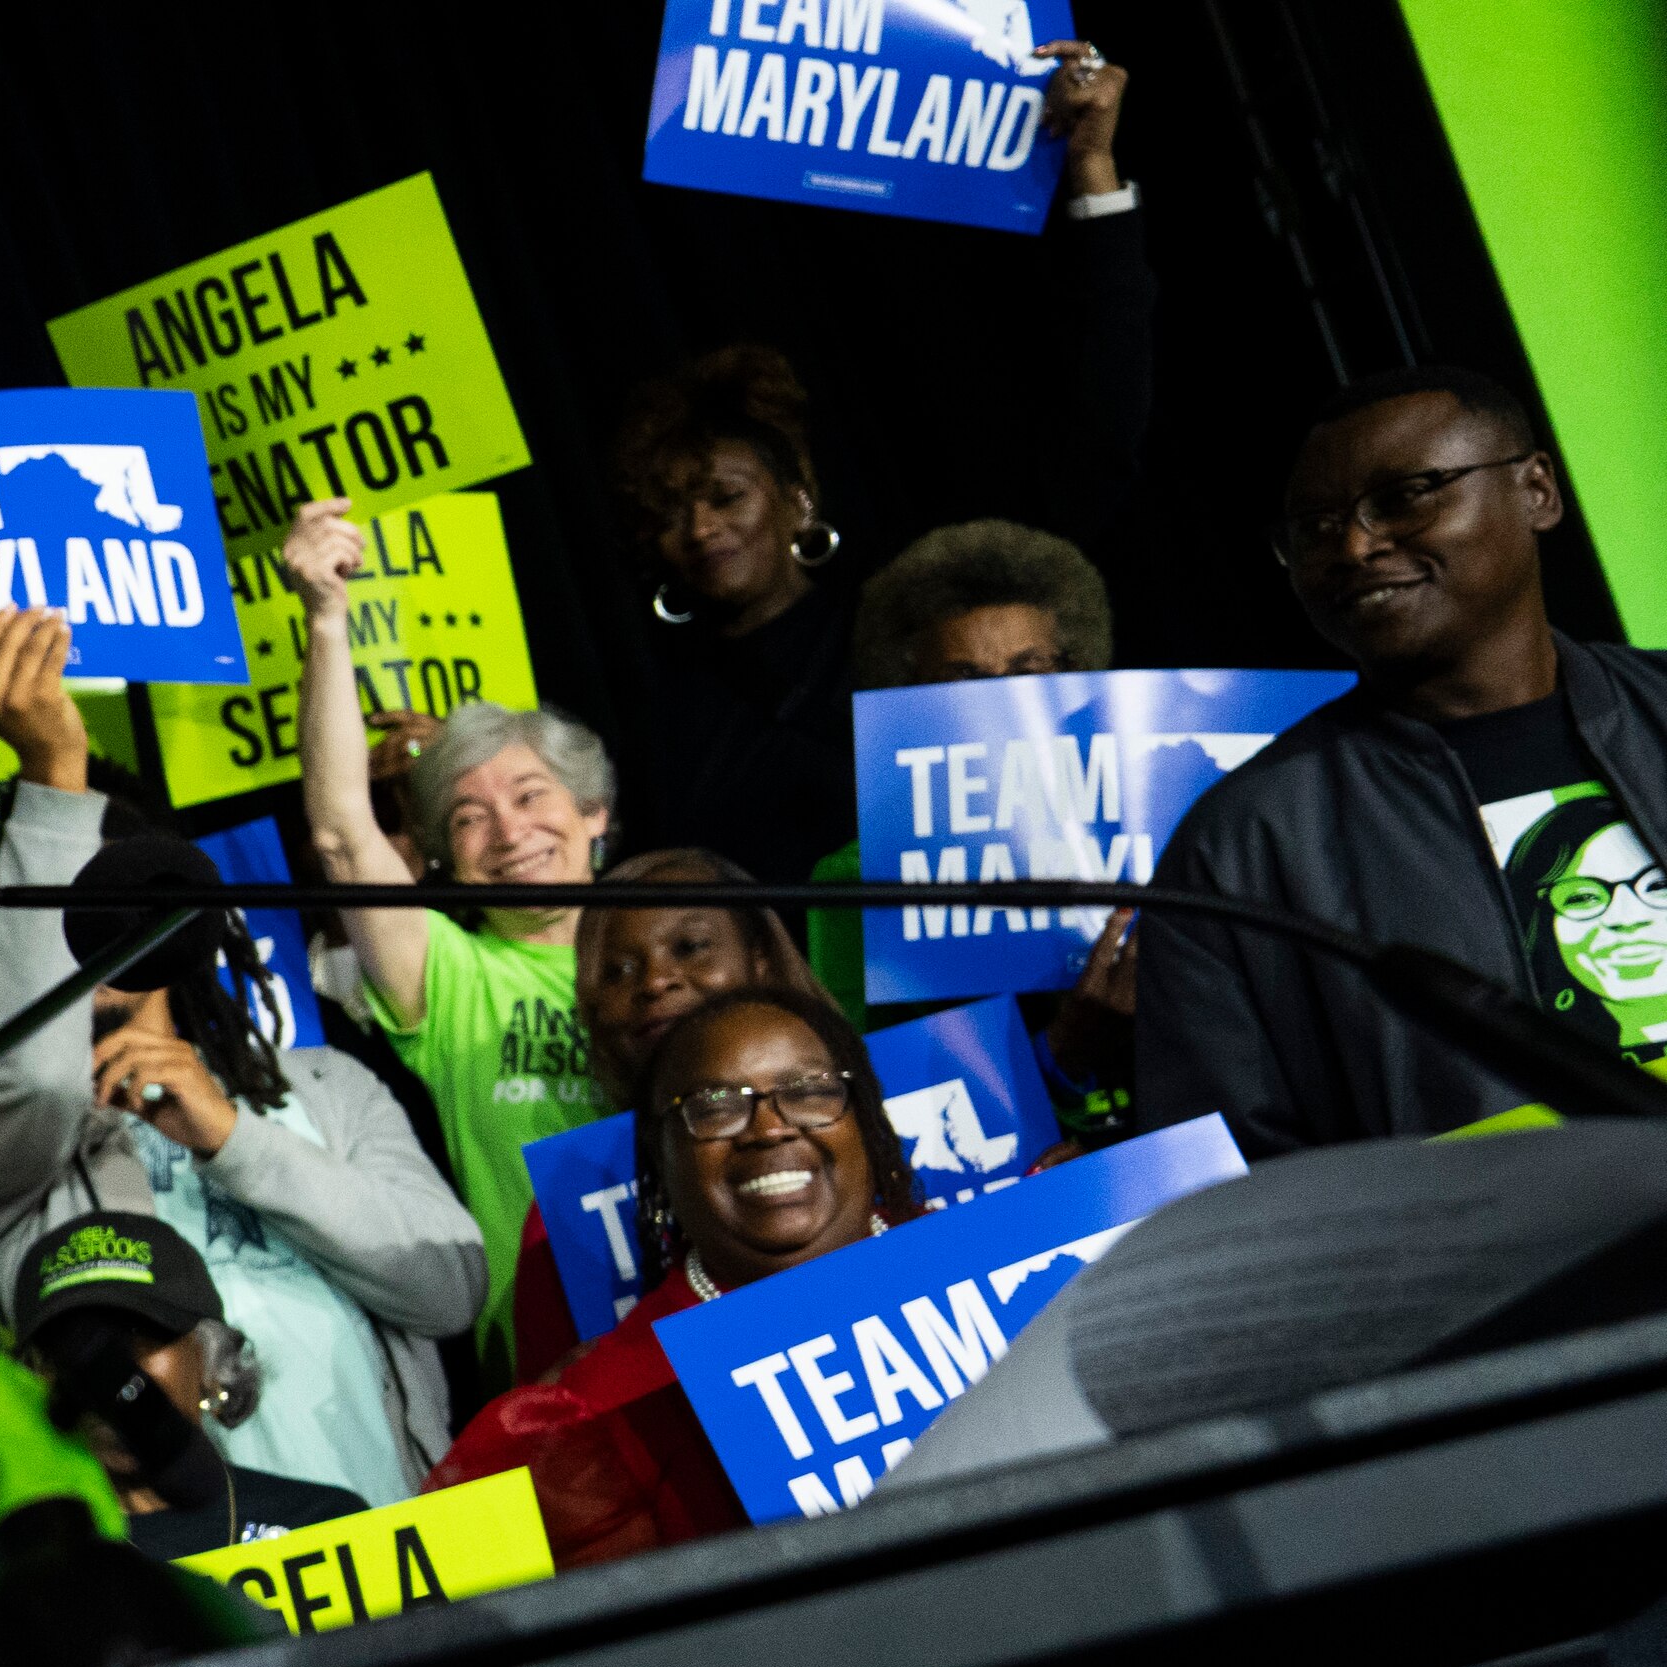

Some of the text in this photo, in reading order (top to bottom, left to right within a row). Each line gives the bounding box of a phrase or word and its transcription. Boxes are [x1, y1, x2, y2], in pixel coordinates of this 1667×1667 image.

[682, 43, 1045, 172] MARYLAND
[124, 231, 369, 388] ANGELA
[205, 354, 318, 441] IS MY
[210, 393, 452, 540] ENATOR
[895, 732, 1121, 838] TEAM
[730, 1278, 1010, 1461] TEAM
